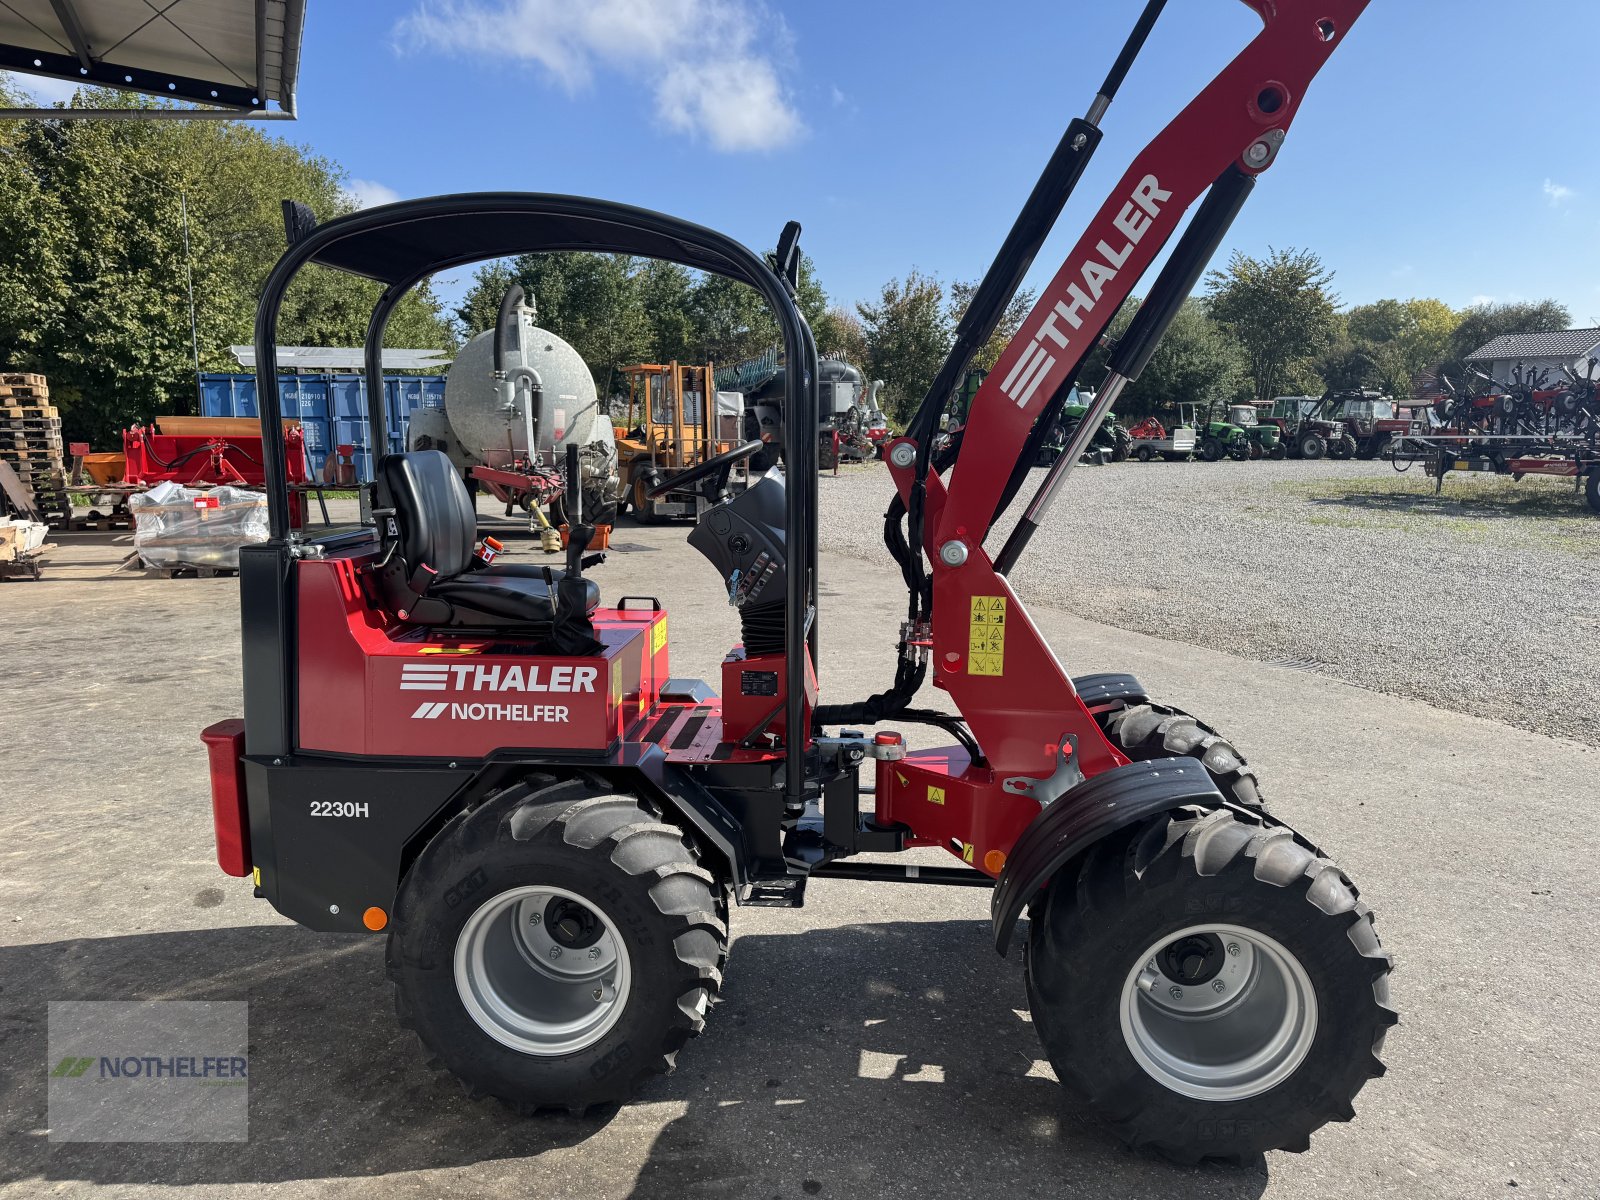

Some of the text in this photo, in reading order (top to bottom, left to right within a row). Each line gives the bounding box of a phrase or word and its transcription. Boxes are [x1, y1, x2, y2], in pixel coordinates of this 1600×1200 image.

[1035, 174, 1173, 350] THALER
[450, 664, 598, 693] THALER
[452, 703, 569, 722] NOTHELFER
[310, 801, 369, 818] 2230H
